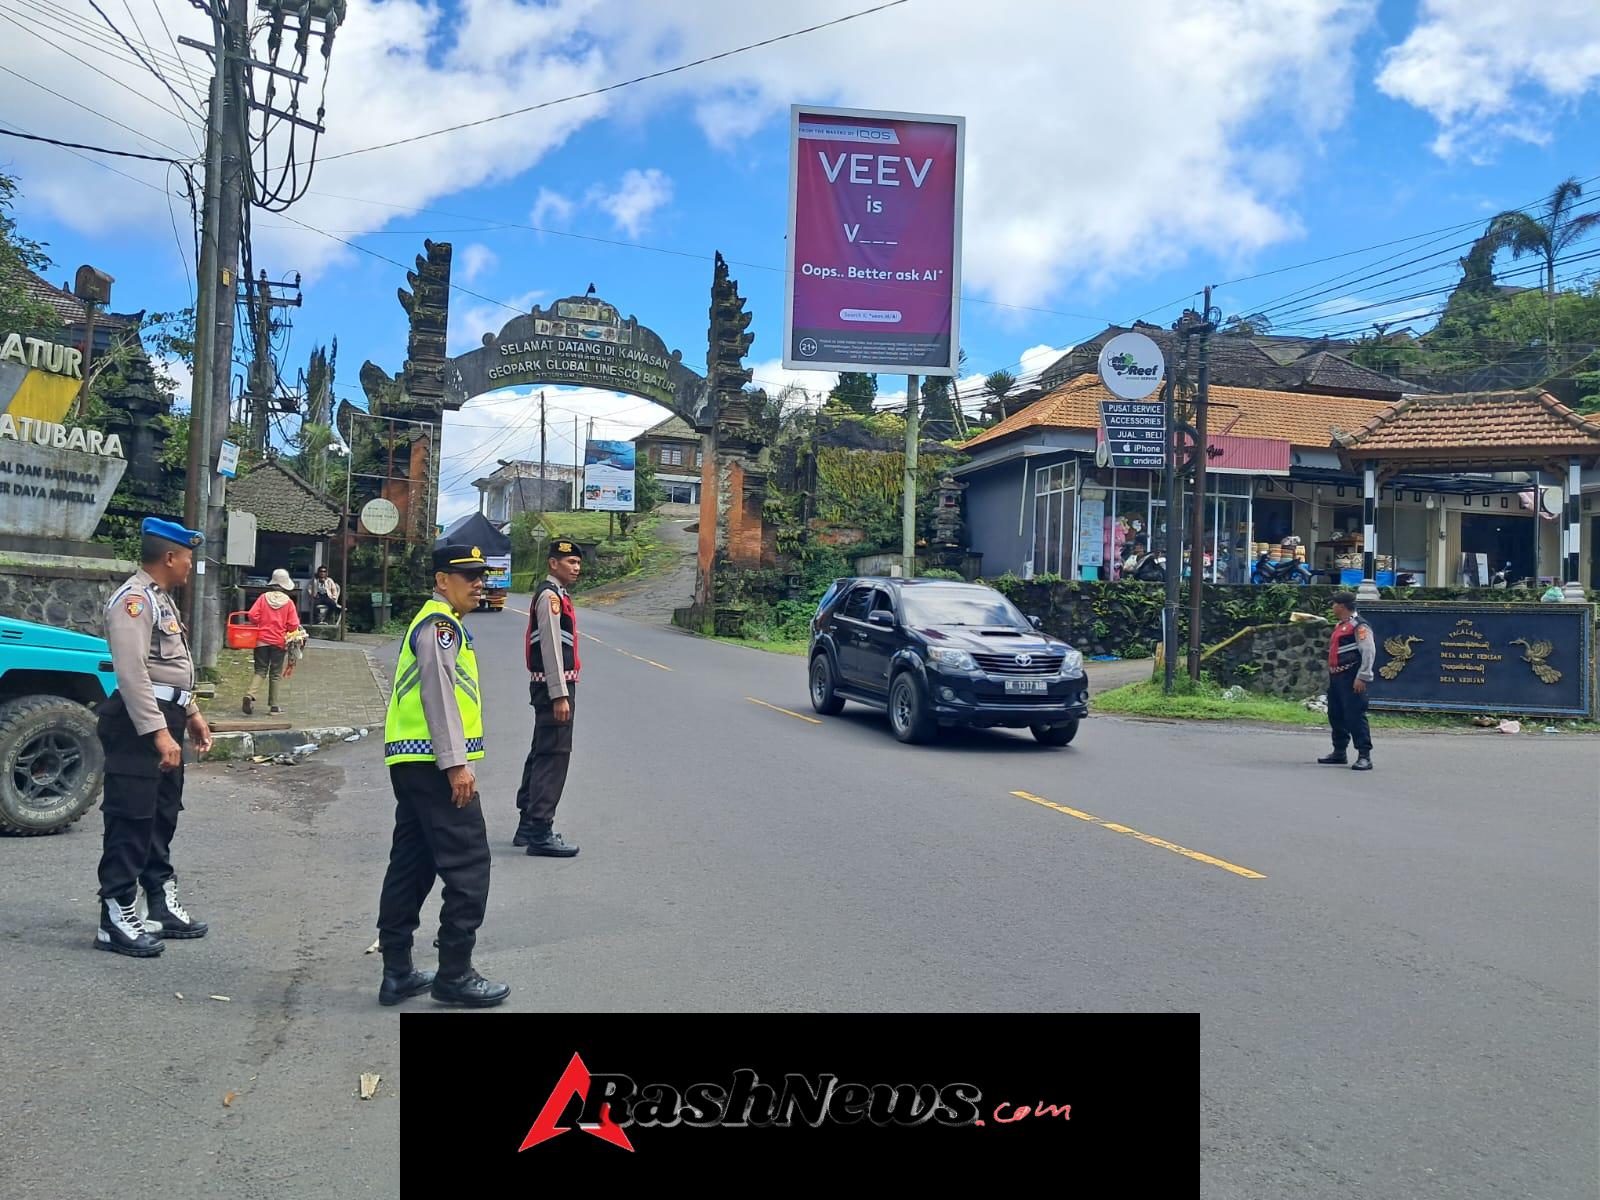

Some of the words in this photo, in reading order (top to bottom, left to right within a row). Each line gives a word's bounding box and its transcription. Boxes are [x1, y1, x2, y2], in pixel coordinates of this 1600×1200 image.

[856, 128, 891, 140] IQOS
[818, 151, 934, 188] VEEV
[866, 195, 883, 213] is
[801, 263, 844, 279] Oops..
[847, 266, 892, 280] Better
[895, 268, 920, 281] ask
[801, 343, 816, 351] 21+
[0, 333, 82, 379] ATUR
[500, 340, 554, 355] SELAMAT
[558, 340, 600, 354] DATANG
[604, 345, 615, 356] DI
[618, 347, 670, 370] KAWASAN
[488, 359, 541, 379] GEOPARK
[546, 359, 590, 373] GLOBAL
[595, 362, 640, 380] UNESCO
[642, 373, 676, 393] BATUR
[1128, 364, 1159, 376] Reef
[1108, 404, 1131, 413] PUSAT
[1132, 405, 1161, 414] SERVICE
[1110, 417, 1162, 425] ACCESSORIES
[1117, 431, 1137, 439] JUAL
[1145, 431, 1163, 439] BELI
[1133, 444, 1161, 452] iPhone
[1133, 457, 1162, 465] android
[15, 463, 42, 478] DAN
[44, 466, 100, 487] BATUBARA
[13, 483, 47, 499] DAYA
[48, 488, 97, 505] MINERAL
